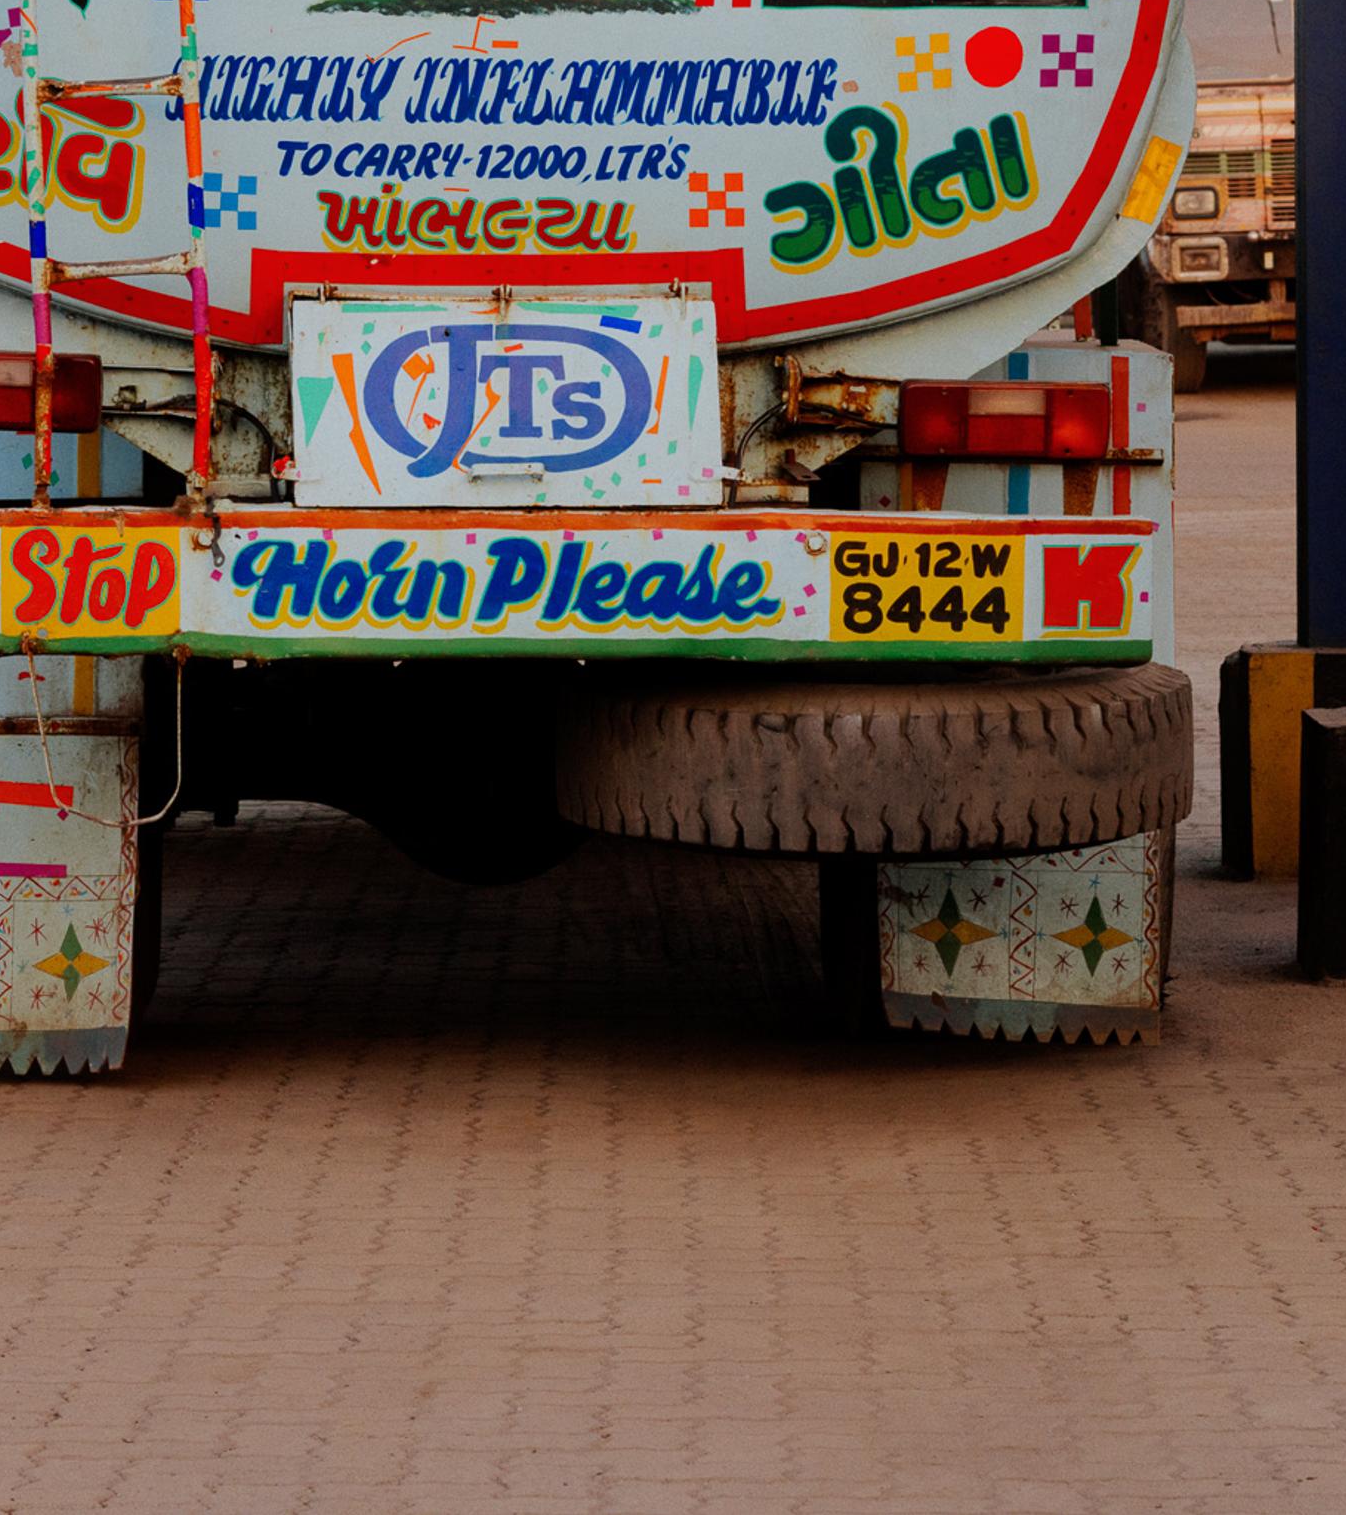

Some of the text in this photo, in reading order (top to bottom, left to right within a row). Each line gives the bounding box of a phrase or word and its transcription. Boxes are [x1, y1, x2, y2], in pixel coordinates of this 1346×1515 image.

[405, 56, 838, 127] INFLAMMABLE
[763, 101, 1039, 275] ગીતા
[231, 536, 785, 633] Horn Please
[842, 582, 1011, 635] 8444
[1041, 542, 1141, 636] K
